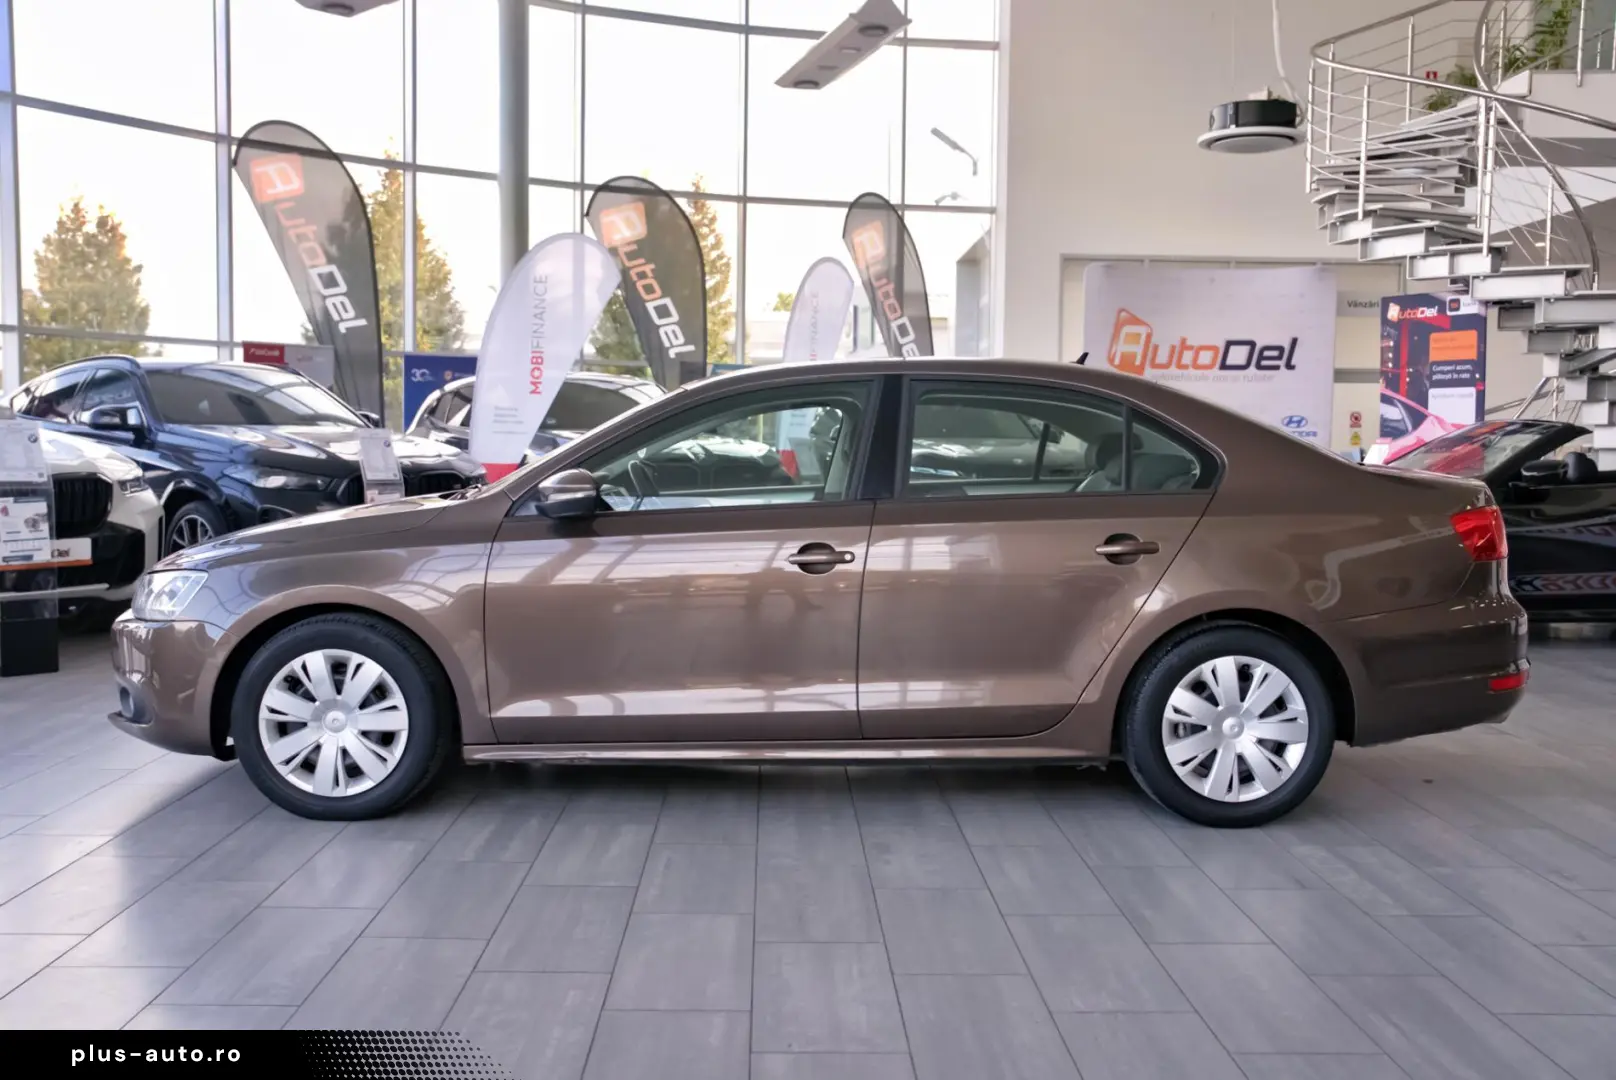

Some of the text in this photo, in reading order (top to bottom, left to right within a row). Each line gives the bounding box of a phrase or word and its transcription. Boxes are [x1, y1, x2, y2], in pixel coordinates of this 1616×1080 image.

[251, 155, 368, 334] AutoDel
[600, 202, 695, 359] AutoDel
[852, 220, 920, 357] AutoDe
[529, 275, 548, 395] MOBIFINANCE
[809, 291, 820, 361] IFINANCE
[1109, 311, 1299, 375] AutoDel
[1387, 302, 1439, 322] AutoDel
